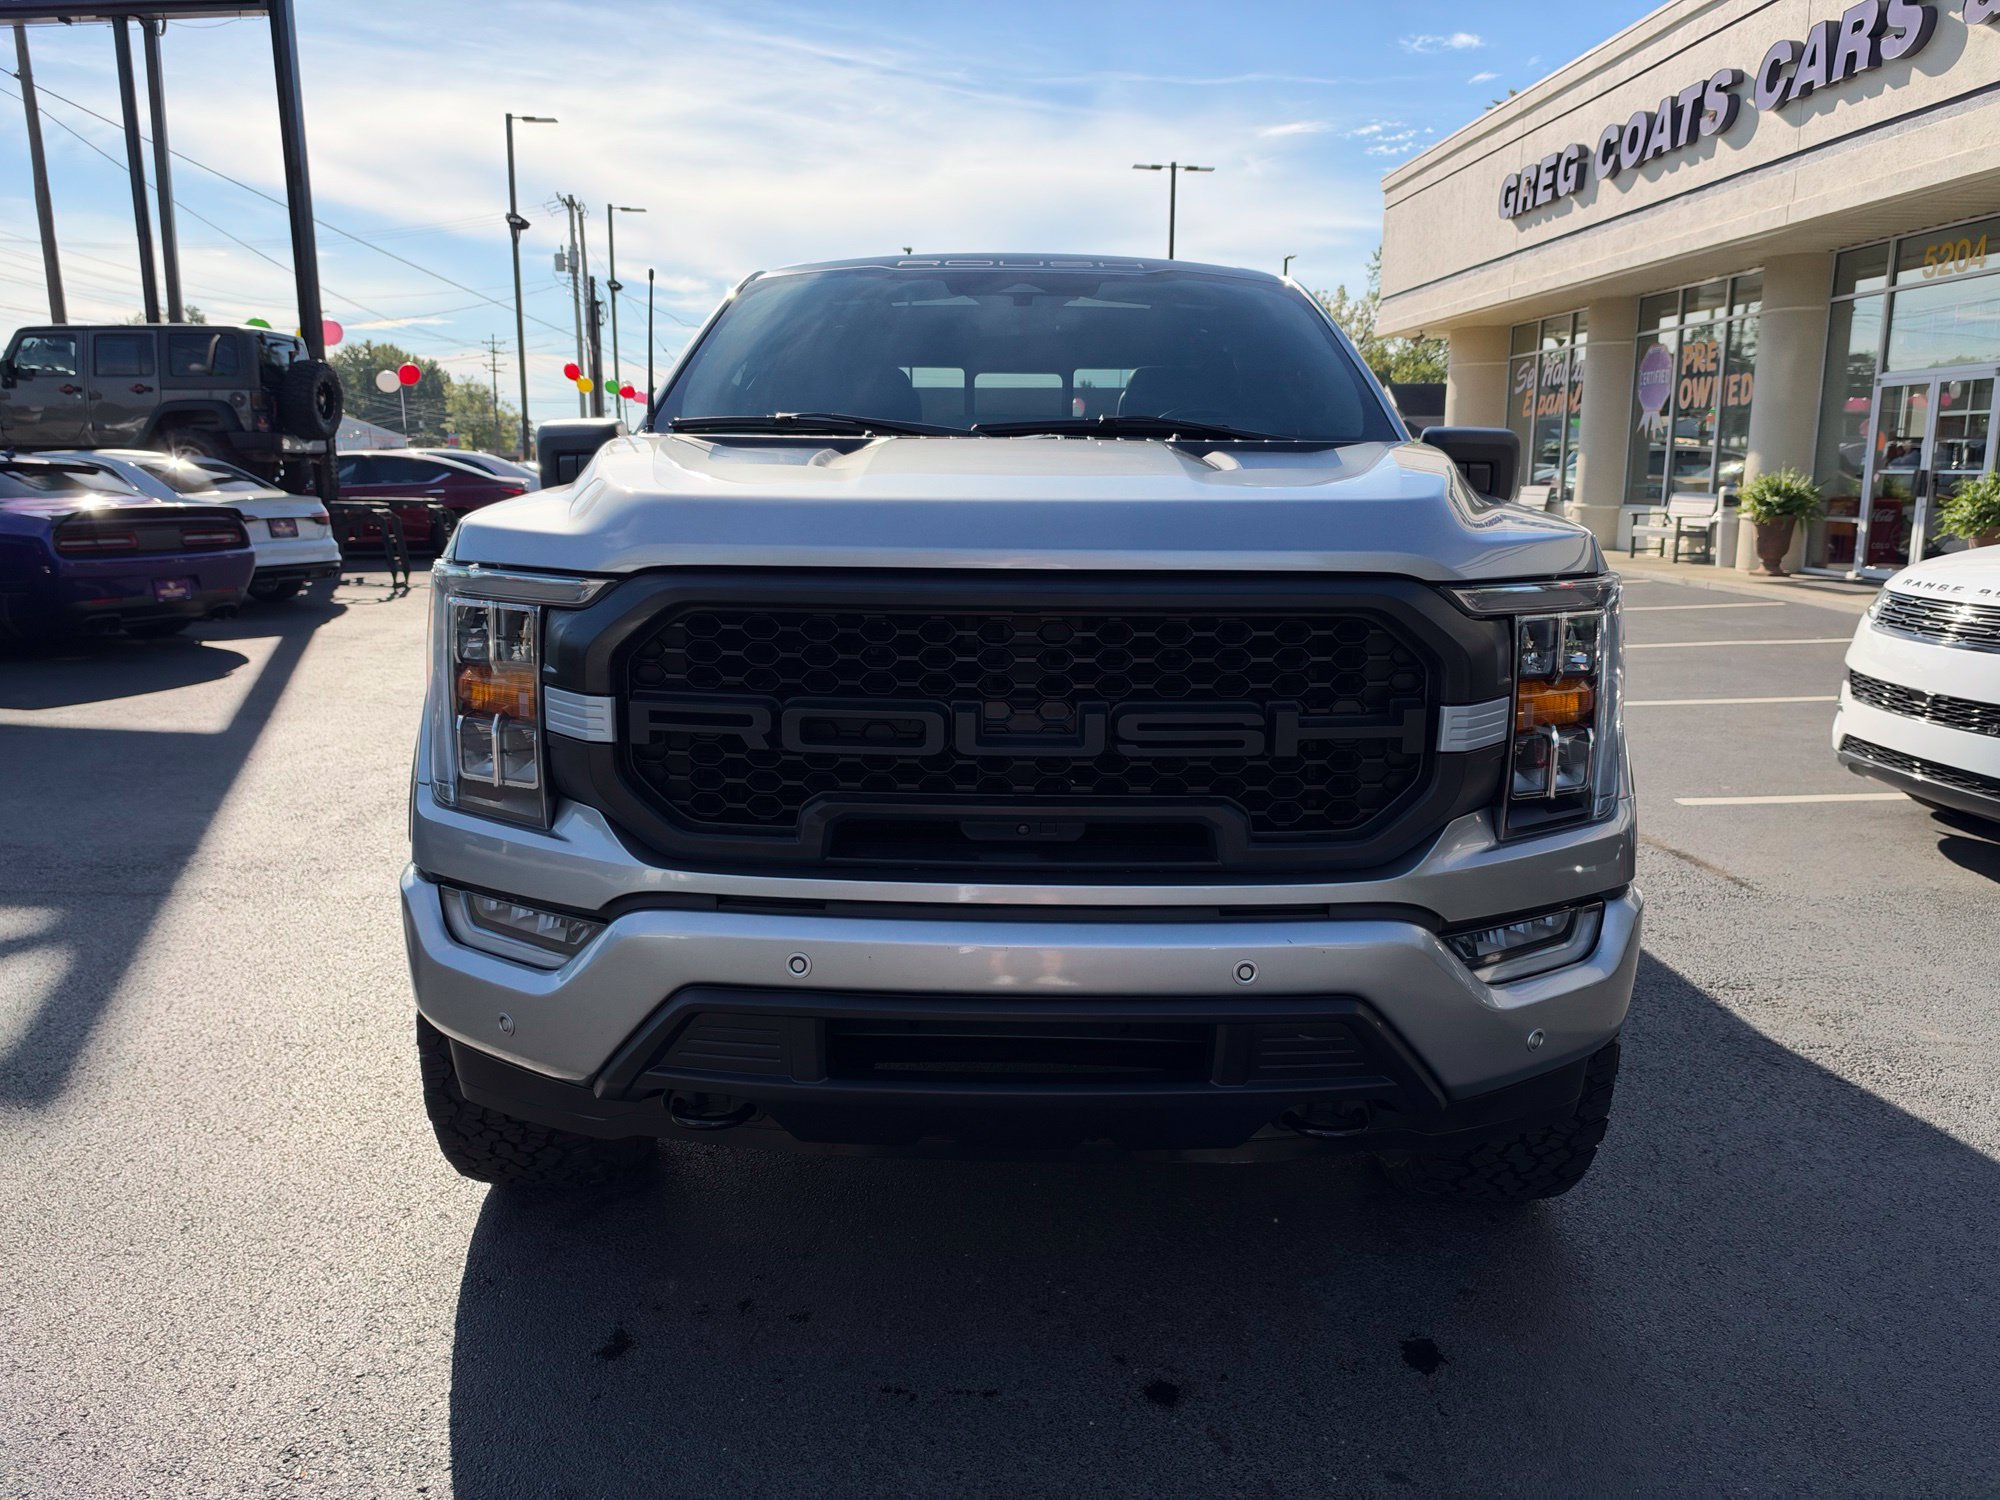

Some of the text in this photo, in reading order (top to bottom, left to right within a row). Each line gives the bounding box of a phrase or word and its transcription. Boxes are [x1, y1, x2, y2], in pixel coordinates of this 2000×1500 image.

[1499, 0, 1936, 219] GREG COATS CARS
[1922, 233, 1987, 279] 5204
[1681, 341, 1718, 375] PRE
[1514, 361, 1536, 394] Se
[1678, 372, 1753, 409] OWNED
[1903, 579, 1965, 593] RANGE
[631, 698, 1427, 759] ROUSH
